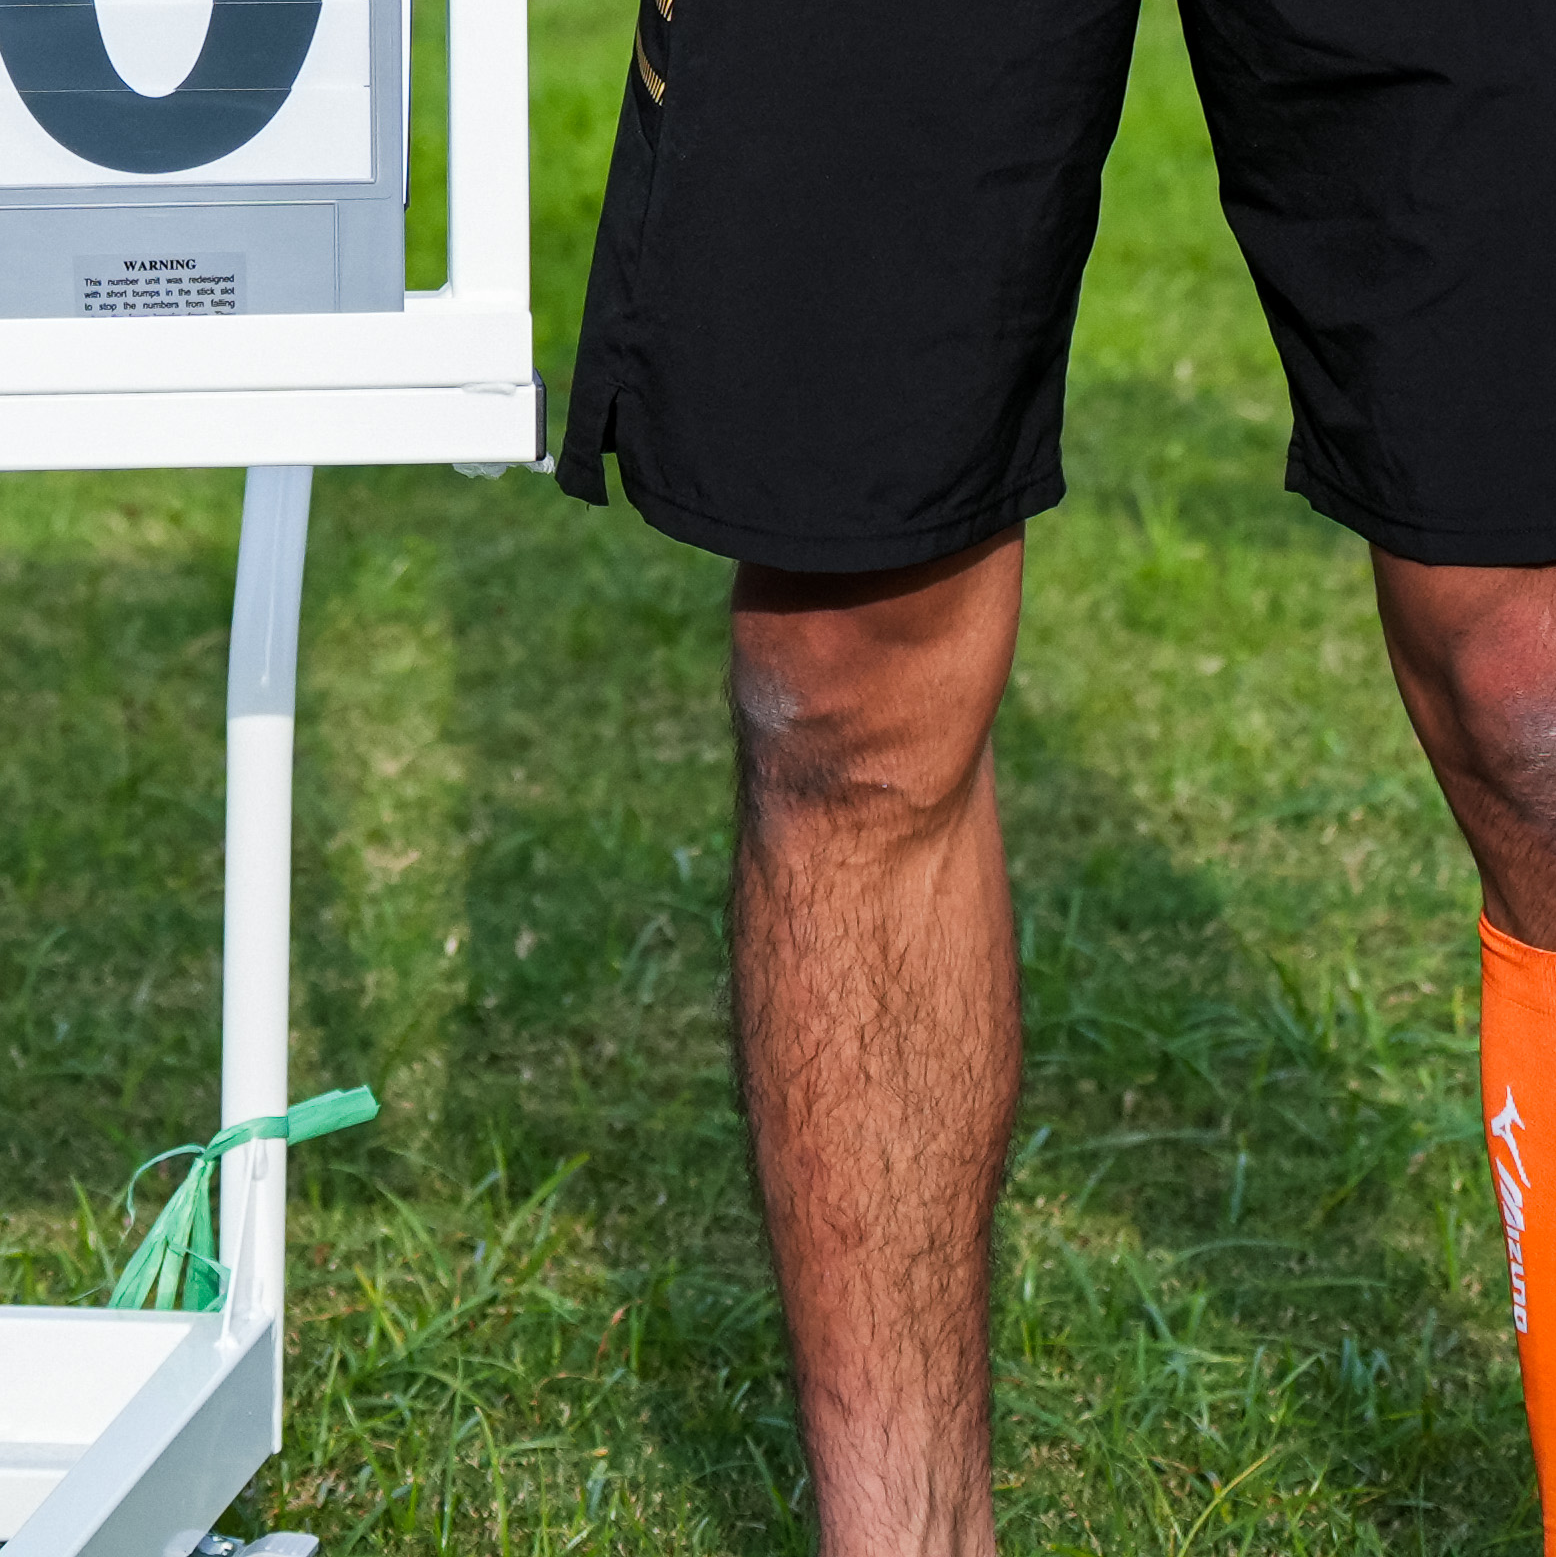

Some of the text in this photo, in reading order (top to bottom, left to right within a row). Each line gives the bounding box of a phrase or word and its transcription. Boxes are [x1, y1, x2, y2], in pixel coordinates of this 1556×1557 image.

[123, 259, 197, 271] WARNING
[84, 274, 234, 287] This number unit was redesigned
[106, 289, 127, 299] short
[132, 288, 160, 299] bumps
[165, 288, 173, 296] in
[178, 288, 191, 296] the
[197, 286, 215, 296] stick
[220, 286, 235, 295] slot
[85, 298, 235, 313] to stop the numbers from falling
